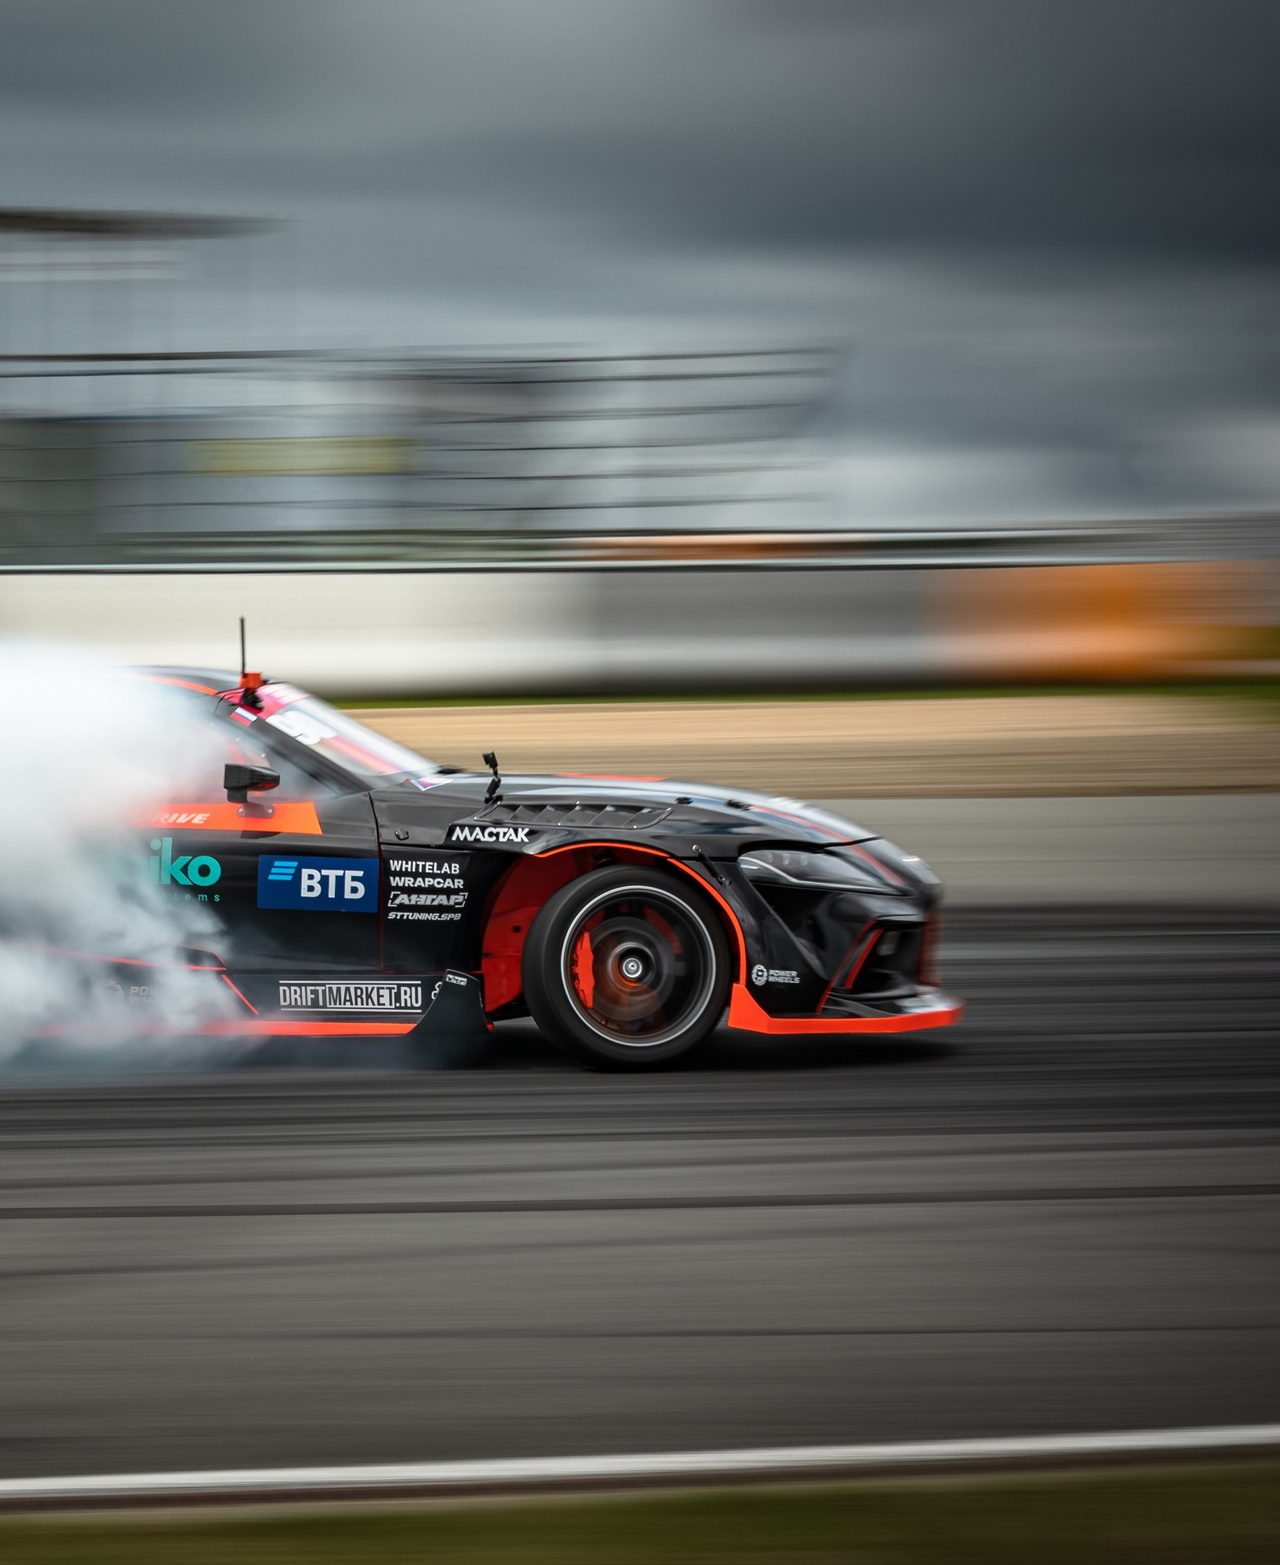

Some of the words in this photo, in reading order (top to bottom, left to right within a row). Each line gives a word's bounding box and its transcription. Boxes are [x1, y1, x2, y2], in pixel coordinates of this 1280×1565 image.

[150, 813, 210, 824] RIVE
[389, 859, 460, 875] WHITELAB
[300, 868, 366, 899] ВТБ
[389, 876, 464, 889] WRAPCAR
[387, 911, 462, 921] STTUNING.SPB
[768, 969, 798, 977] POWER
[768, 976, 800, 984] WHEELS
[279, 985, 423, 1008] DRIFTMARKET.RU
